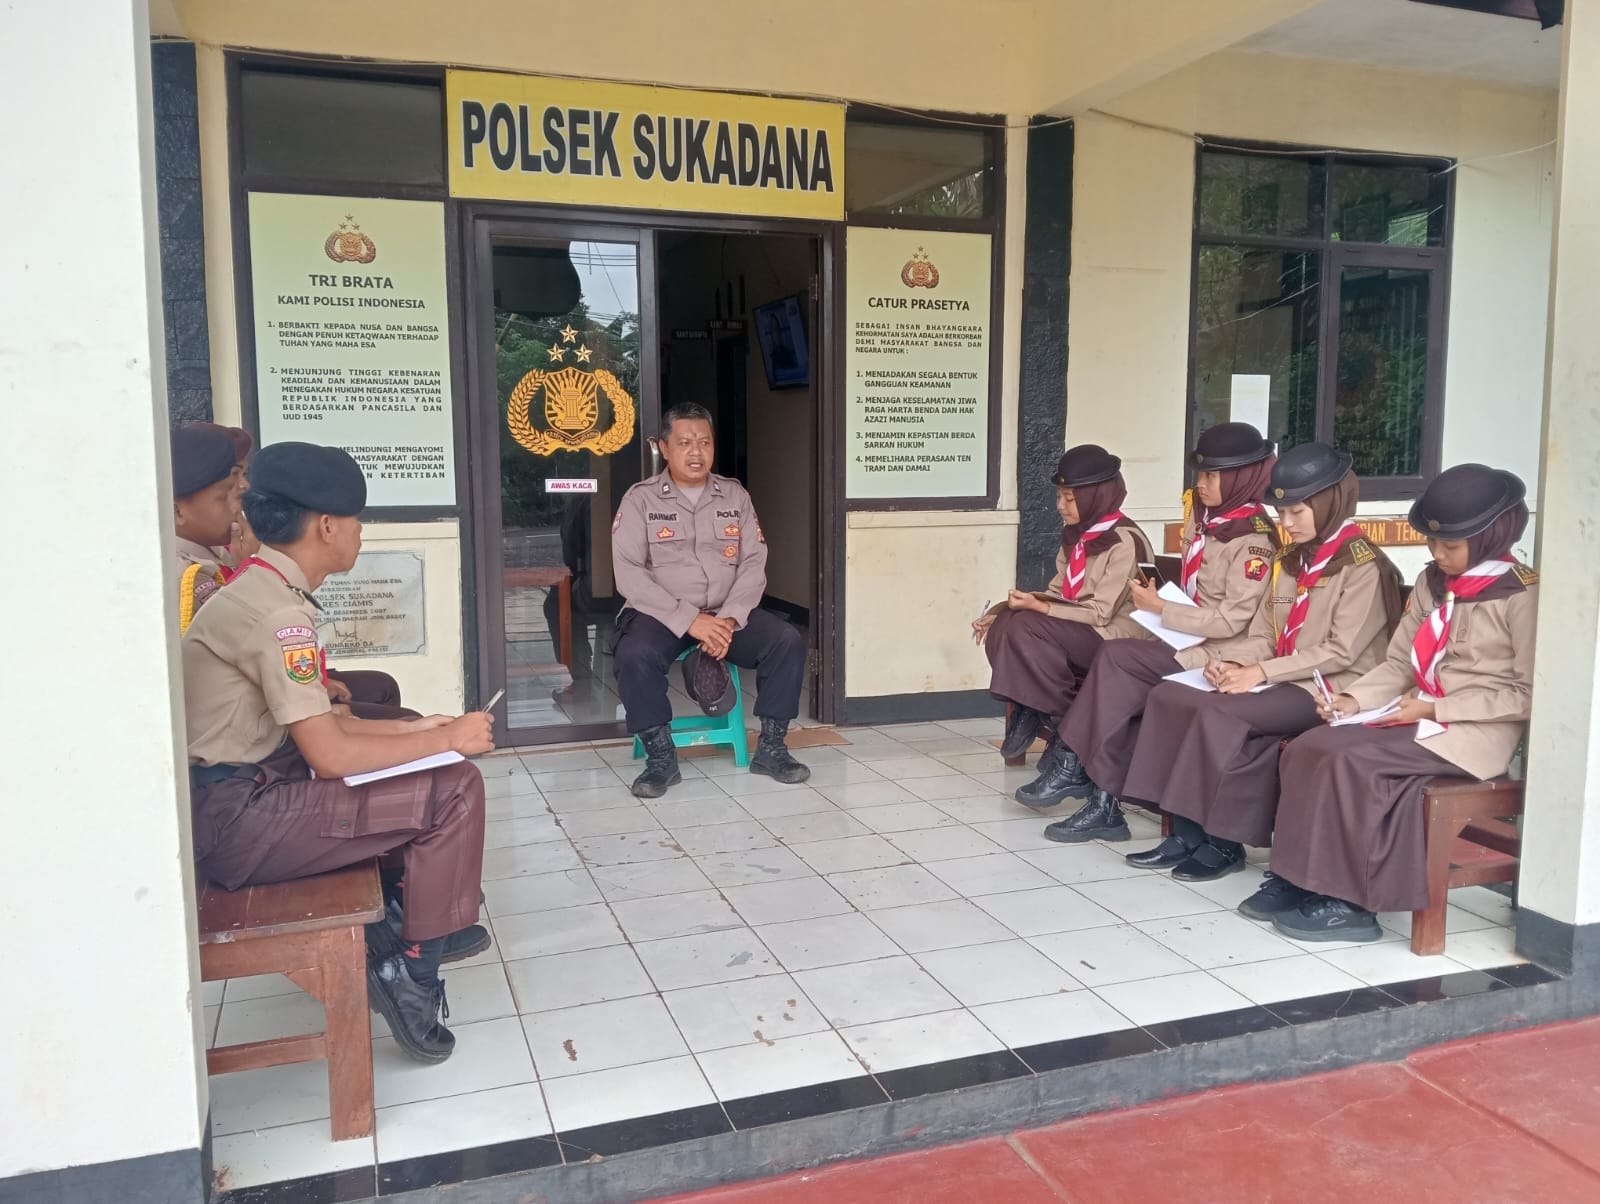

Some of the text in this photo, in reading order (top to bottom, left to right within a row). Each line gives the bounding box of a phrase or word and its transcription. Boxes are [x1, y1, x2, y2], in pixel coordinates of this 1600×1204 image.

[462, 100, 834, 193] POLSEK SUKADANA
[309, 275, 393, 288] TRI BRATA
[278, 296, 425, 309] KAMI POLISI INDONESIA
[868, 297, 969, 311] CATUR PRASETYA
[649, 513, 677, 521] RAHMAT
